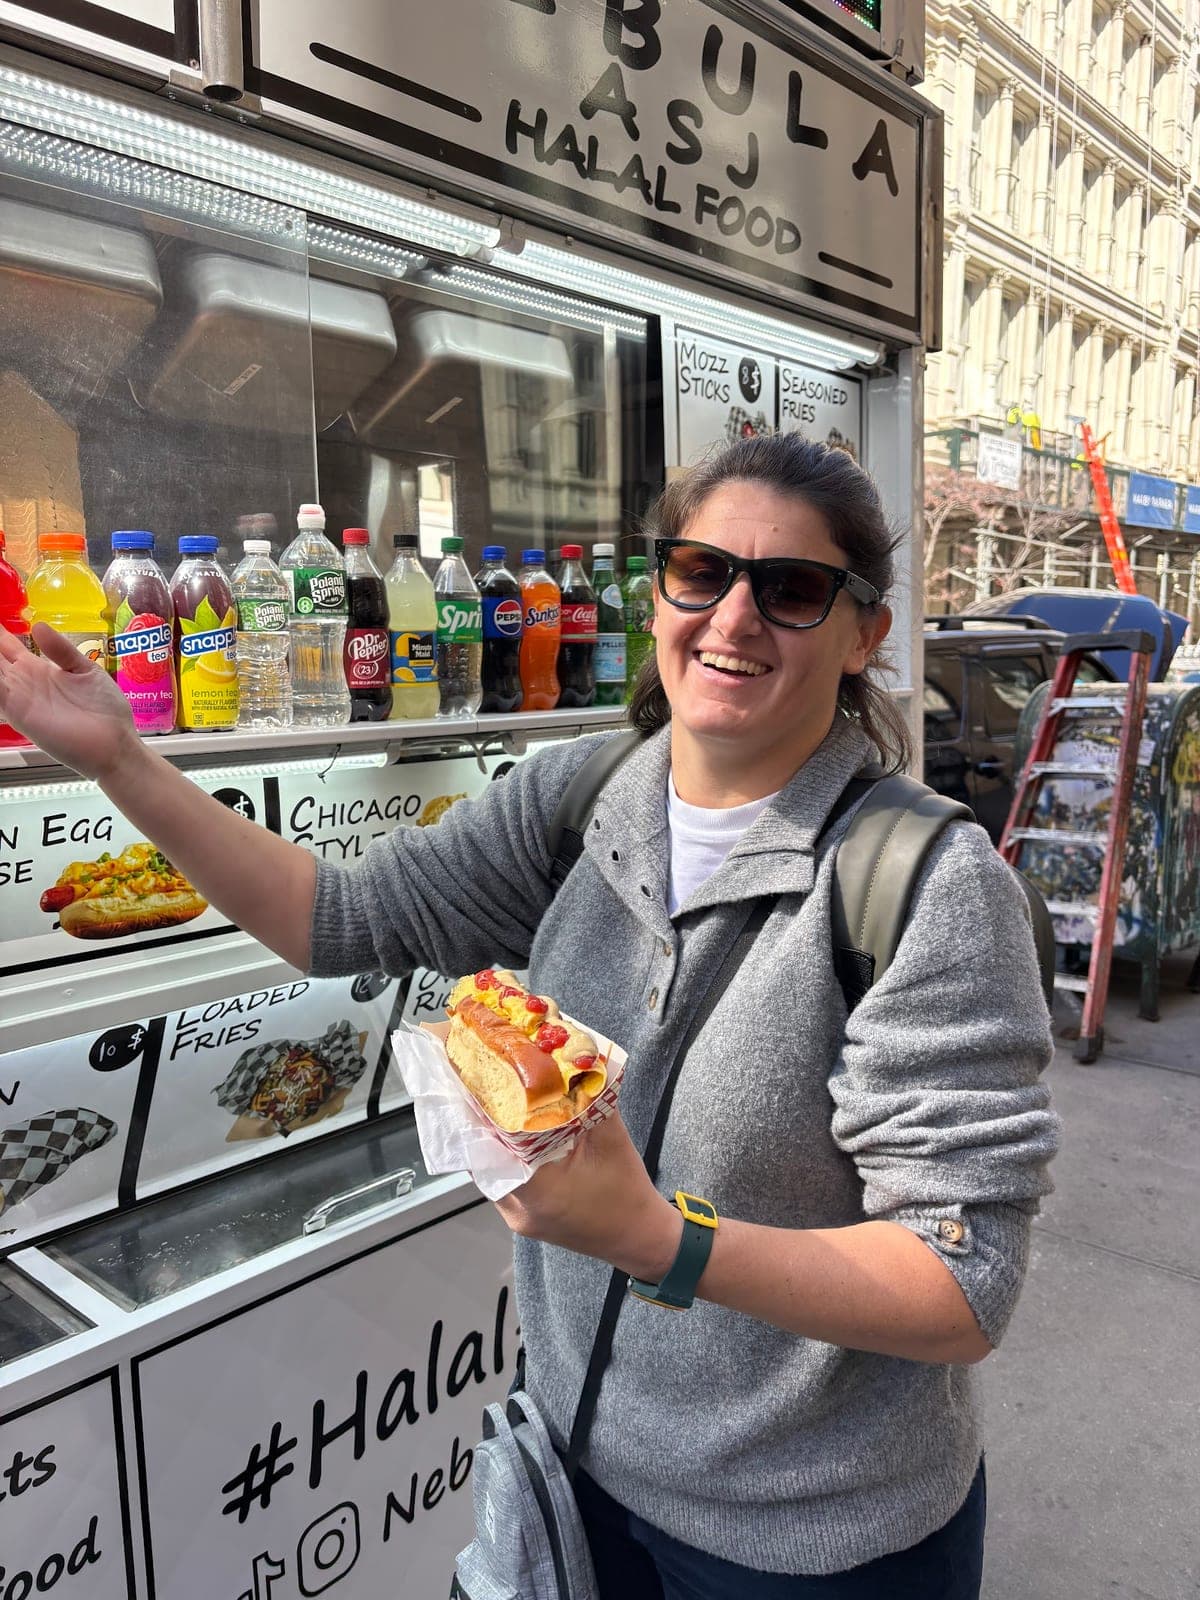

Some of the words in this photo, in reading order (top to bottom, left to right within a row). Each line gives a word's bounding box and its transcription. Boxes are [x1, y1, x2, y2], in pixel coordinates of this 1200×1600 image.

[507, 0, 898, 197] BULA
[505, 98, 682, 214] HALAL
[694, 182, 802, 255] FOOD
[679, 342, 730, 375] MOZZ
[679, 366, 731, 404] STICKS
[781, 367, 848, 406] SEASONED
[782, 398, 816, 423] FRIES
[310, 573, 343, 591] Poland
[312, 585, 344, 604] Spring
[254, 602, 284, 618] Poland
[256, 613, 285, 629] Spring
[438, 605, 482, 634] Spri
[496, 613, 522, 621] PEPS
[108, 629, 171, 653] snapple
[183, 630, 237, 650] snappl
[353, 636, 387, 661] Pepper
[364, 633, 380, 648] Dr
[151, 652, 166, 661] tea
[360, 665, 371, 674] 23
[191, 689, 224, 698] lemon
[290, 794, 421, 832] CHICAGO
[41, 813, 112, 847] EGG
[175, 980, 311, 1031] LOADED
[169, 1018, 263, 1061] FRIES
[221, 1285, 525, 1524] #Halal
[0, 1444, 57, 1498] ts
[383, 1436, 474, 1542] Neb
